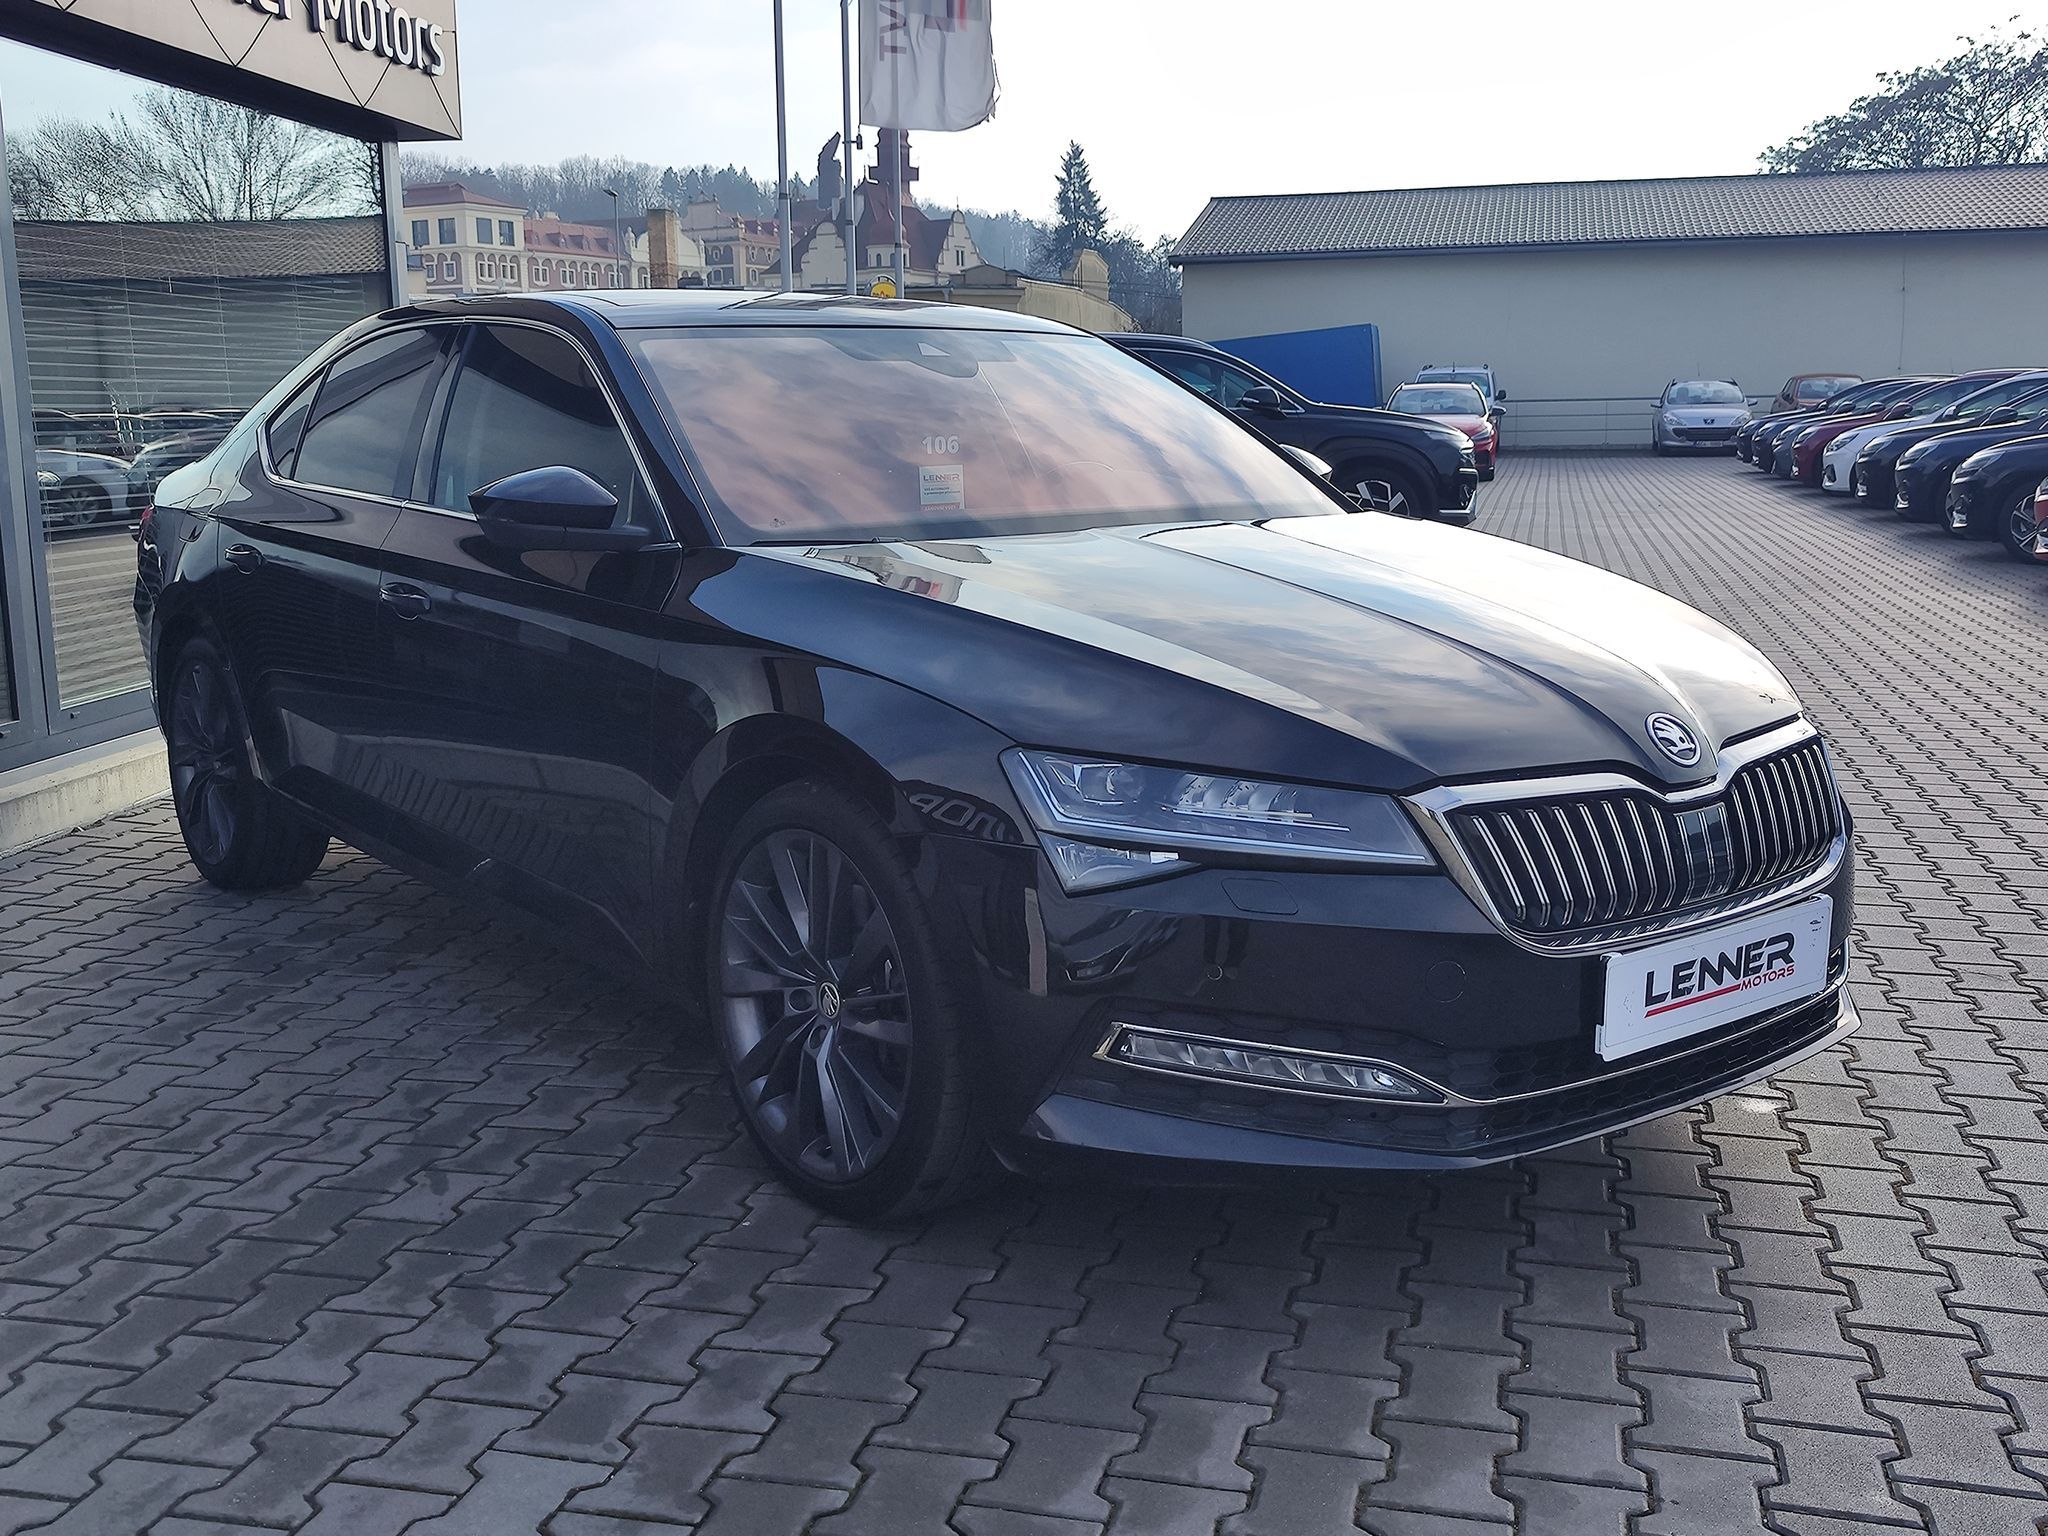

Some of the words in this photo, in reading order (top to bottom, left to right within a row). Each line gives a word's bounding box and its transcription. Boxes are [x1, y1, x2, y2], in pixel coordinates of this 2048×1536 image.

[921, 435, 960, 455] 106
[923, 473, 960, 482] LENNER
[1645, 932, 1796, 1008] LENNER
[1740, 964, 1796, 992] MOTORS
